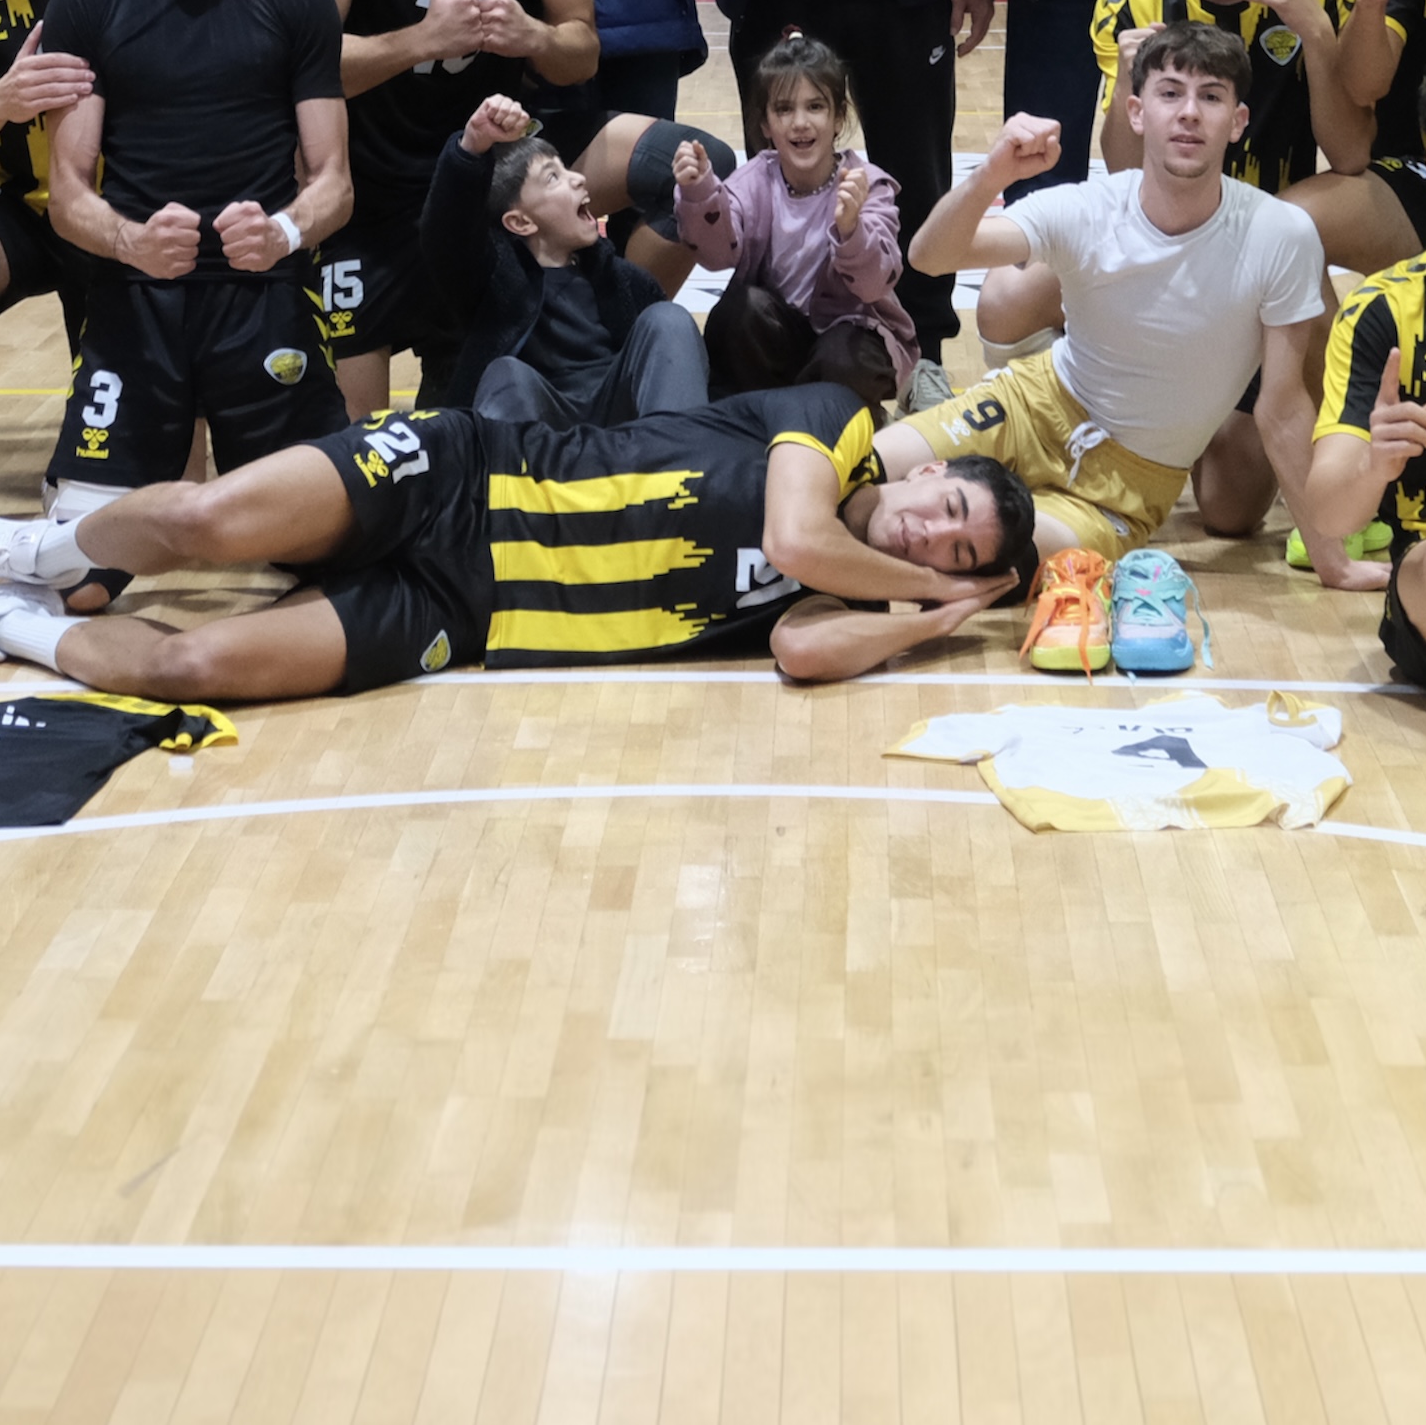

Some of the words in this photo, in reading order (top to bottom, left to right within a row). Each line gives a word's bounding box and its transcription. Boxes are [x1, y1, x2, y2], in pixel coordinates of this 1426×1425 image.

[320, 258, 365, 312] 15
[82, 368, 124, 429] 3
[362, 421, 430, 485] 21
